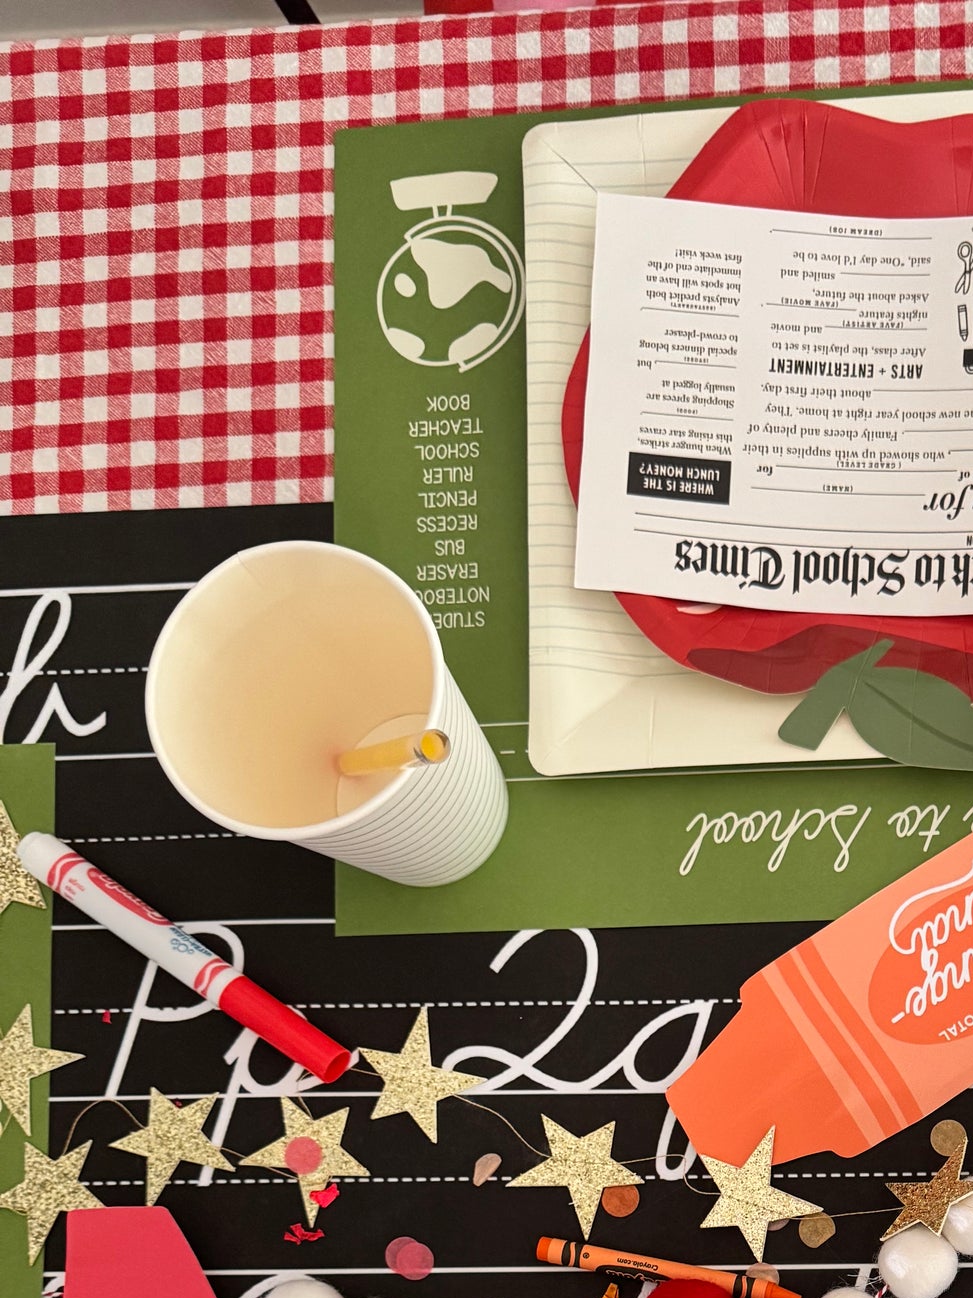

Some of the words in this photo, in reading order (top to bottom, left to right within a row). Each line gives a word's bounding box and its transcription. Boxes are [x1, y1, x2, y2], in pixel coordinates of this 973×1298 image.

[674, 248, 696, 258] visit!
[699, 251, 721, 260] week
[792, 252, 804, 262] be
[806, 253, 817, 263] to
[724, 254, 742, 264] first
[820, 254, 840, 265] love
[859, 255, 876, 266] day
[907, 256, 930, 267] said,
[647, 261, 661, 270] the
[662, 262, 673, 272] of
[675, 264, 692, 273] end
[694, 265, 740, 278] immediate
[780, 269, 798, 278] and
[802, 270, 835, 282] smiled
[645, 275, 656, 283] an
[658, 276, 679, 286] have
[668, 292, 700, 302] predict
[702, 294, 740, 306] Analysts
[812, 288, 845, 301] future,
[848, 292, 864, 302] the
[867, 292, 895, 302] about
[898, 293, 928, 303] Asked
[858, 310, 893, 321] feature
[896, 310, 927, 321] nights
[770, 322, 800, 333] movie
[803, 326, 822, 335] and
[664, 329, 726, 341] crowd-pleaser
[638, 340, 668, 352] belong
[670, 344, 704, 355] dinners
[707, 346, 737, 357] special
[771, 342, 781, 351] to
[784, 342, 798, 352] set
[801, 344, 810, 353] is
[812, 344, 849, 356] playlist
[851, 347, 867, 357] the
[871, 346, 896, 358] class,
[900, 348, 926, 357] After
[768, 358, 873, 378] ENTERTAINMENT
[890, 364, 922, 379] ARTS
[672, 380, 701, 392] logged
[703, 382, 735, 394] usually
[760, 384, 782, 396] day.
[784, 386, 806, 398] first
[809, 388, 836, 400] their
[839, 390, 871, 400] about
[426, 394, 471, 412] BOOK
[662, 394, 690, 404] sprees
[692, 396, 734, 409] Shopping
[764, 404, 791, 417] They
[795, 407, 828, 420] home.
[831, 410, 842, 420] at
[845, 408, 872, 422] right
[875, 408, 898, 420] year
[938, 411, 960, 419] new
[901, 411, 936, 422] school
[408, 417, 483, 437] TEACHER
[638, 427, 666, 435] craves
[746, 424, 759, 435] of
[762, 424, 796, 438] plenty
[800, 428, 820, 439] and
[823, 429, 858, 440] cheers
[860, 429, 897, 441] Family
[636, 438, 669, 449] strikes,
[670, 441, 702, 453] hunger
[414, 442, 480, 461] SCHOOL
[705, 444, 731, 455] When
[742, 444, 768, 455] their
[772, 446, 782, 456] in
[785, 446, 830, 459] supplies
[834, 450, 858, 460] with
[861, 449, 875, 460] up
[879, 451, 918, 462] showed
[922, 451, 944, 461] who
[423, 465, 473, 484] RULER
[638, 463, 682, 478] MONEY?
[686, 468, 719, 481] LUNCH
[756, 465, 772, 476] for
[957, 471, 969, 481] of
[642, 478, 662, 490] THE
[666, 480, 675, 492] IS
[678, 482, 713, 495] WHERE
[418, 489, 477, 508] PENCIL
[922, 484, 973, 520] for
[416, 514, 478, 533] RECESS
[434, 539, 465, 556] BUS
[673, 538, 785, 590] Times
[416, 562, 479, 581] ERASER
[792, 546, 908, 597] School
[914, 554, 944, 592] to
[888, 800, 952, 852] to
[679, 803, 872, 876] School
[617, 1257, 658, 1271] Crayola.com
